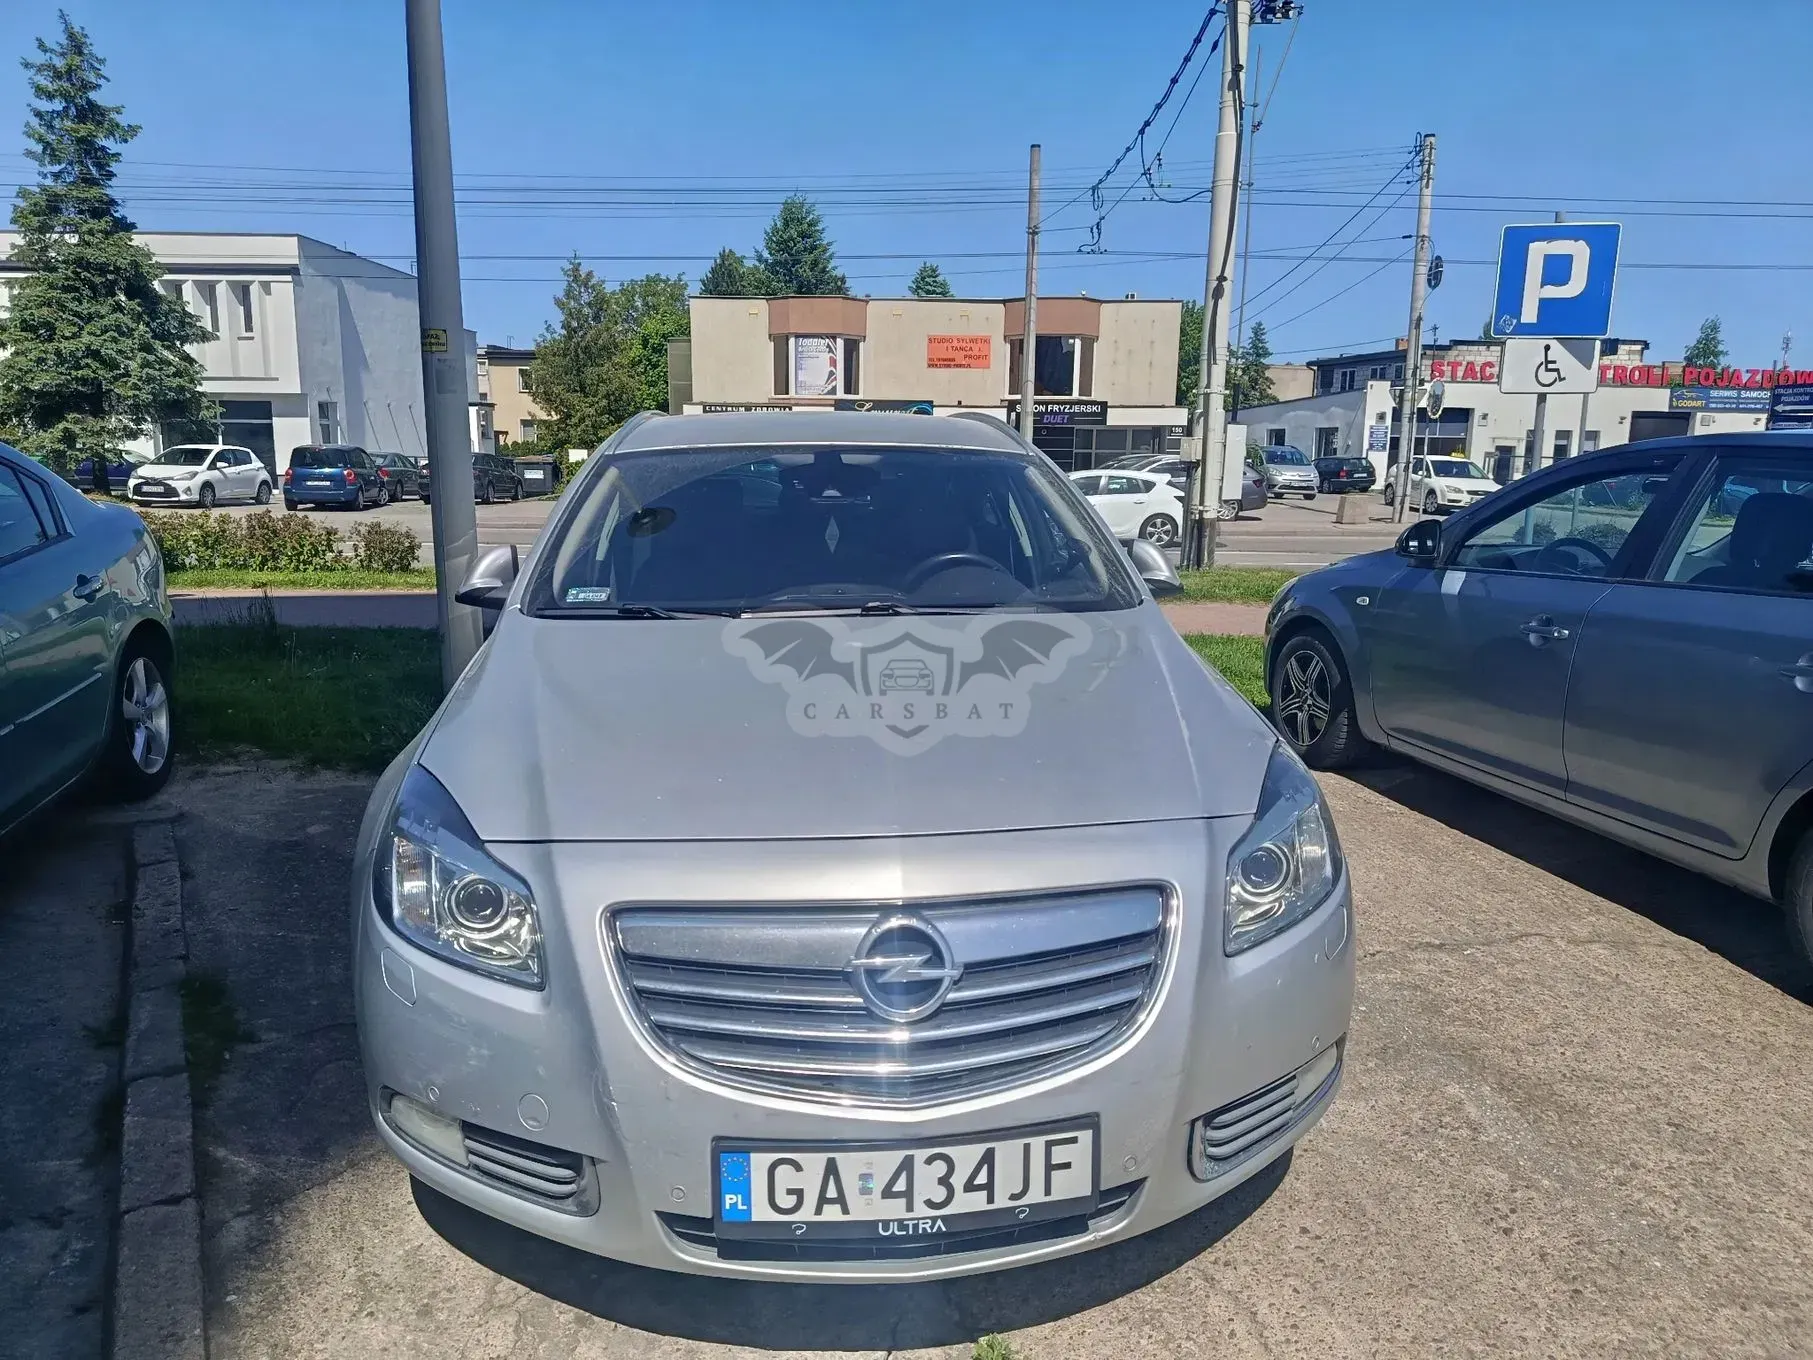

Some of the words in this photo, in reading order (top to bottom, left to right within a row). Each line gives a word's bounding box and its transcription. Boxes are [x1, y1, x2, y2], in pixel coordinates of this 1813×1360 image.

[1521, 240, 1591, 323] P
[1430, 360, 1498, 382] STAC
[1599, 364, 1671, 387] TROLI
[1682, 364, 1813, 388] POJAZDÓW
[1709, 389, 1739, 398] SERWIS
[1015, 404, 1046, 412] SON
[1047, 404, 1102, 413] FRYZJERSKI
[1043, 414, 1070, 423] DUET
[766, 1156, 851, 1216] GA
[880, 1135, 1080, 1214] 434JF
[724, 1194, 748, 1210] PL
[878, 1219, 947, 1236] ULTRA
